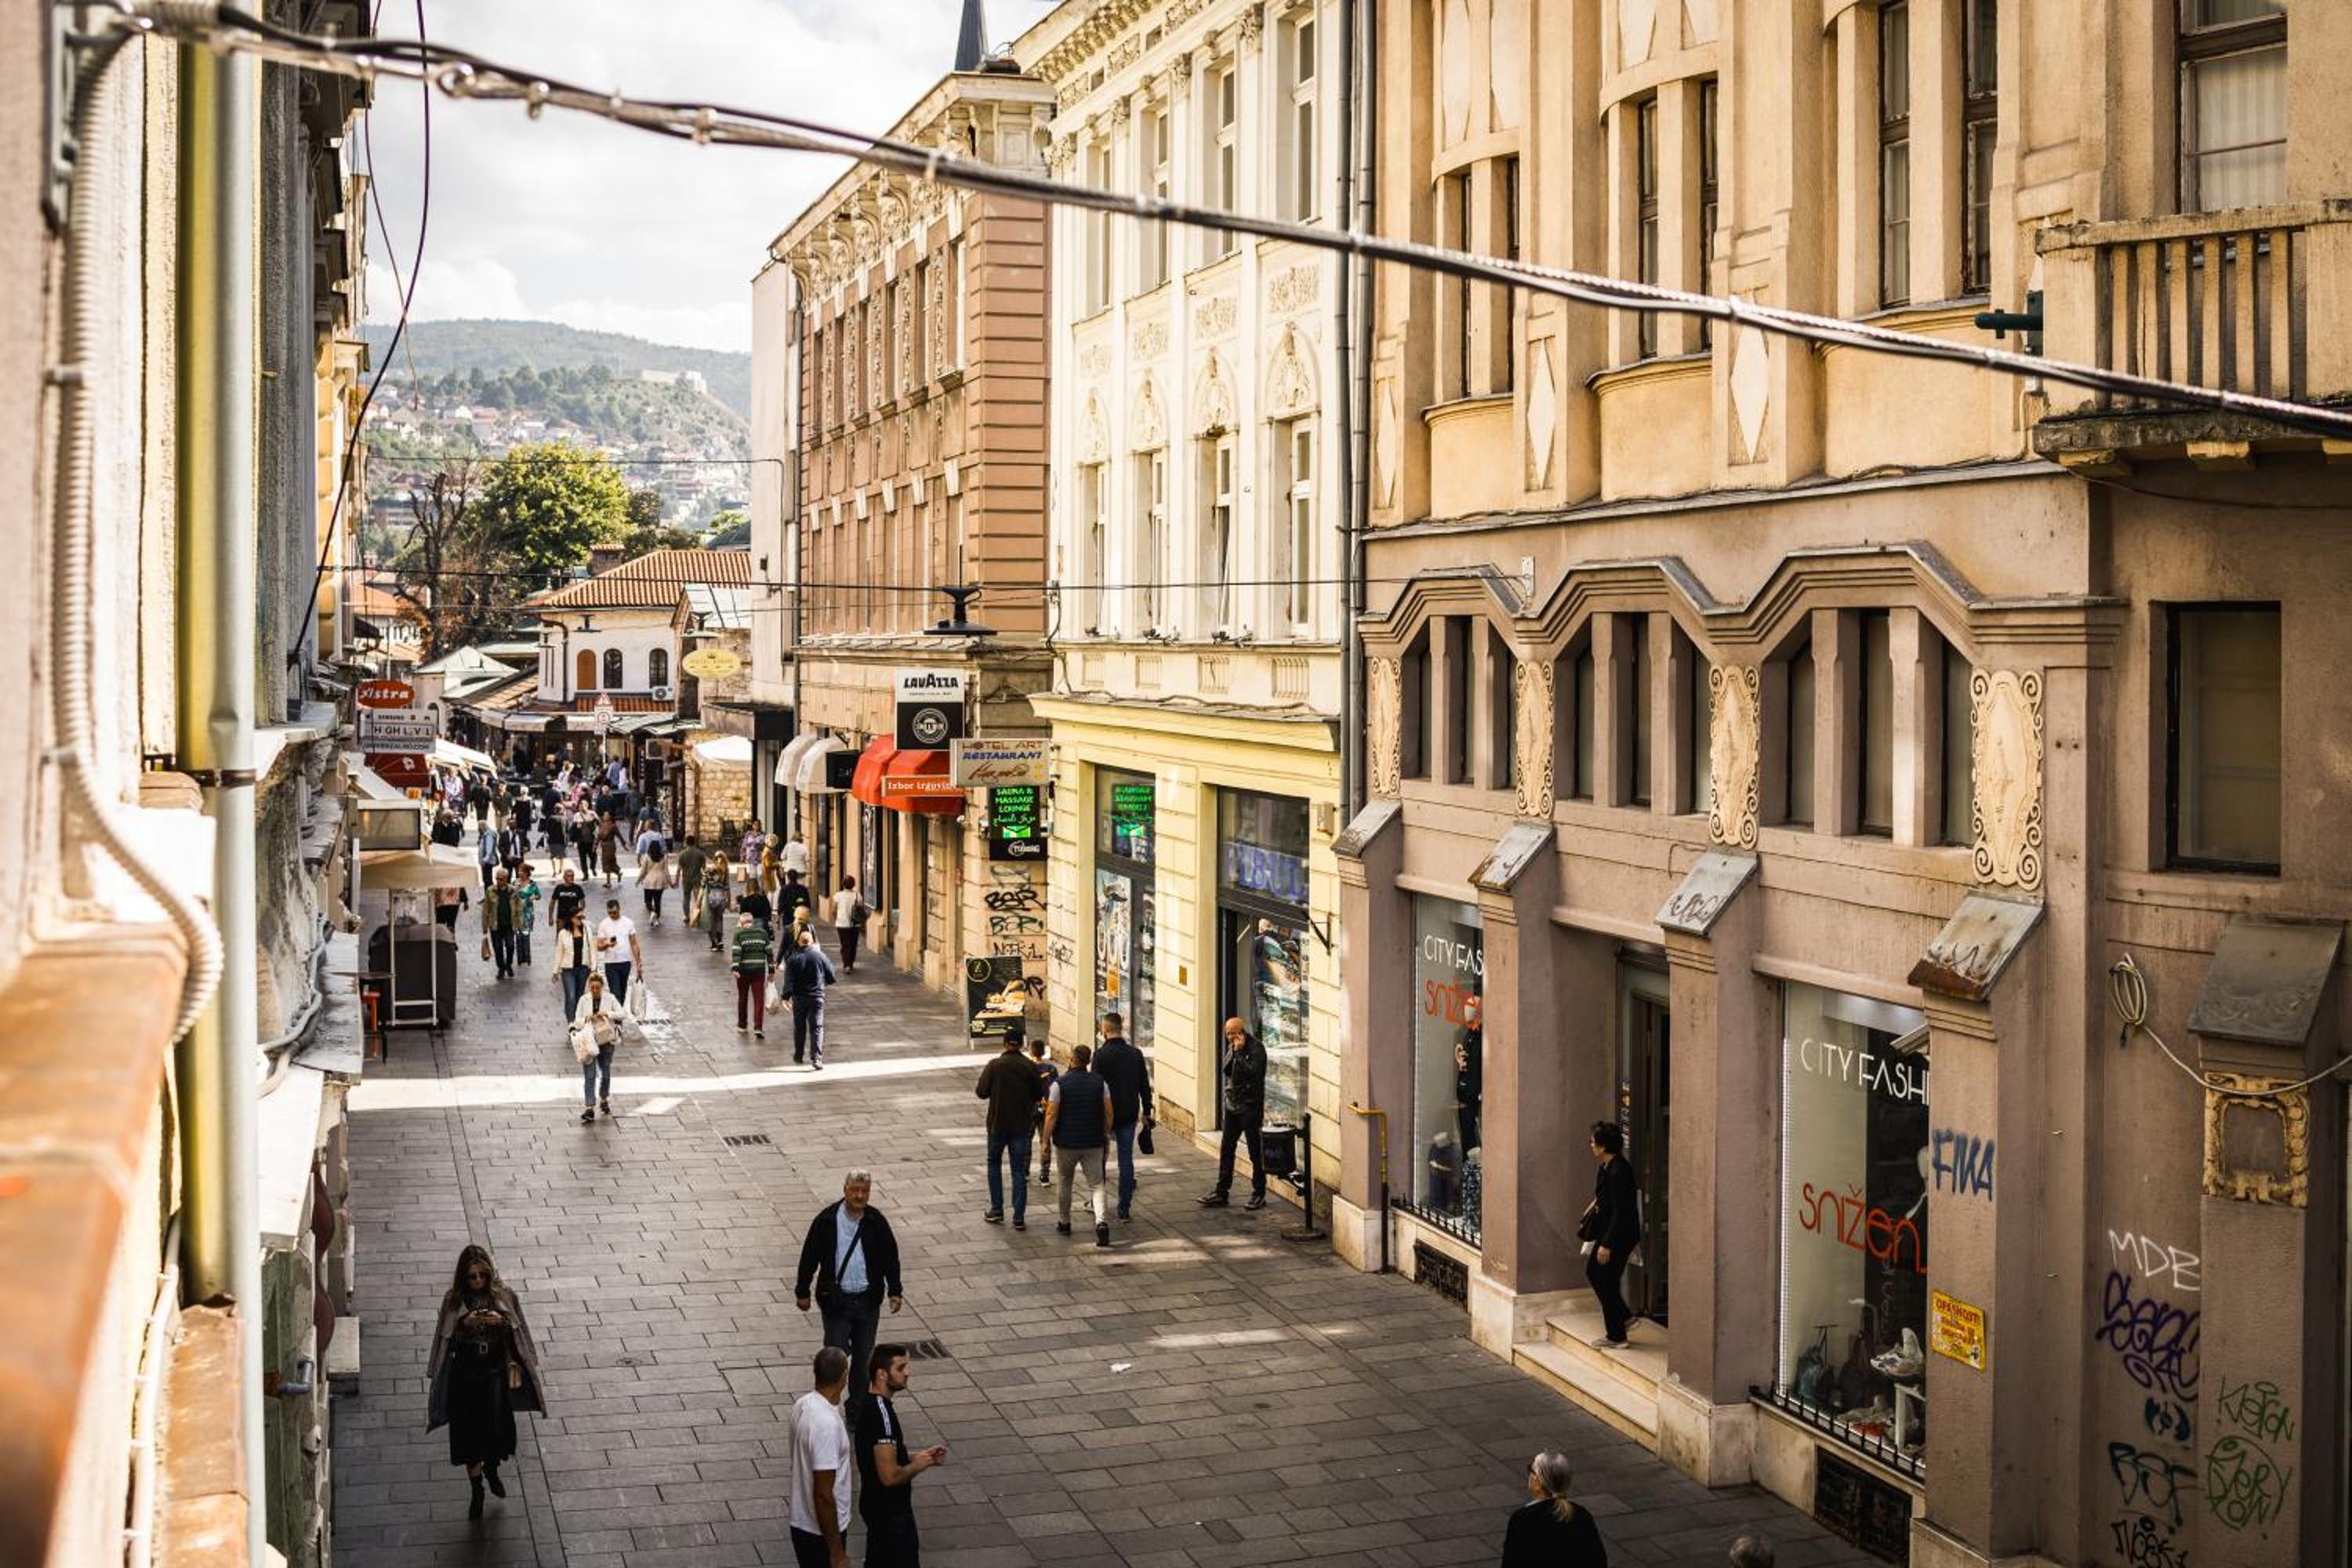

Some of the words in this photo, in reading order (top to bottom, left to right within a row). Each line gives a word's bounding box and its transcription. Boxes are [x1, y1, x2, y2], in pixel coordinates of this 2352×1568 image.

[903, 673, 959, 688] LAVAZZA
[962, 741, 1010, 750] HOTEL
[1015, 740, 1044, 750] ART
[963, 751, 1043, 760] RESTAURANT
[998, 804, 1030, 813] LOUNGE
[1425, 935, 1454, 967] CITY
[1801, 1037, 1852, 1082] CITY
